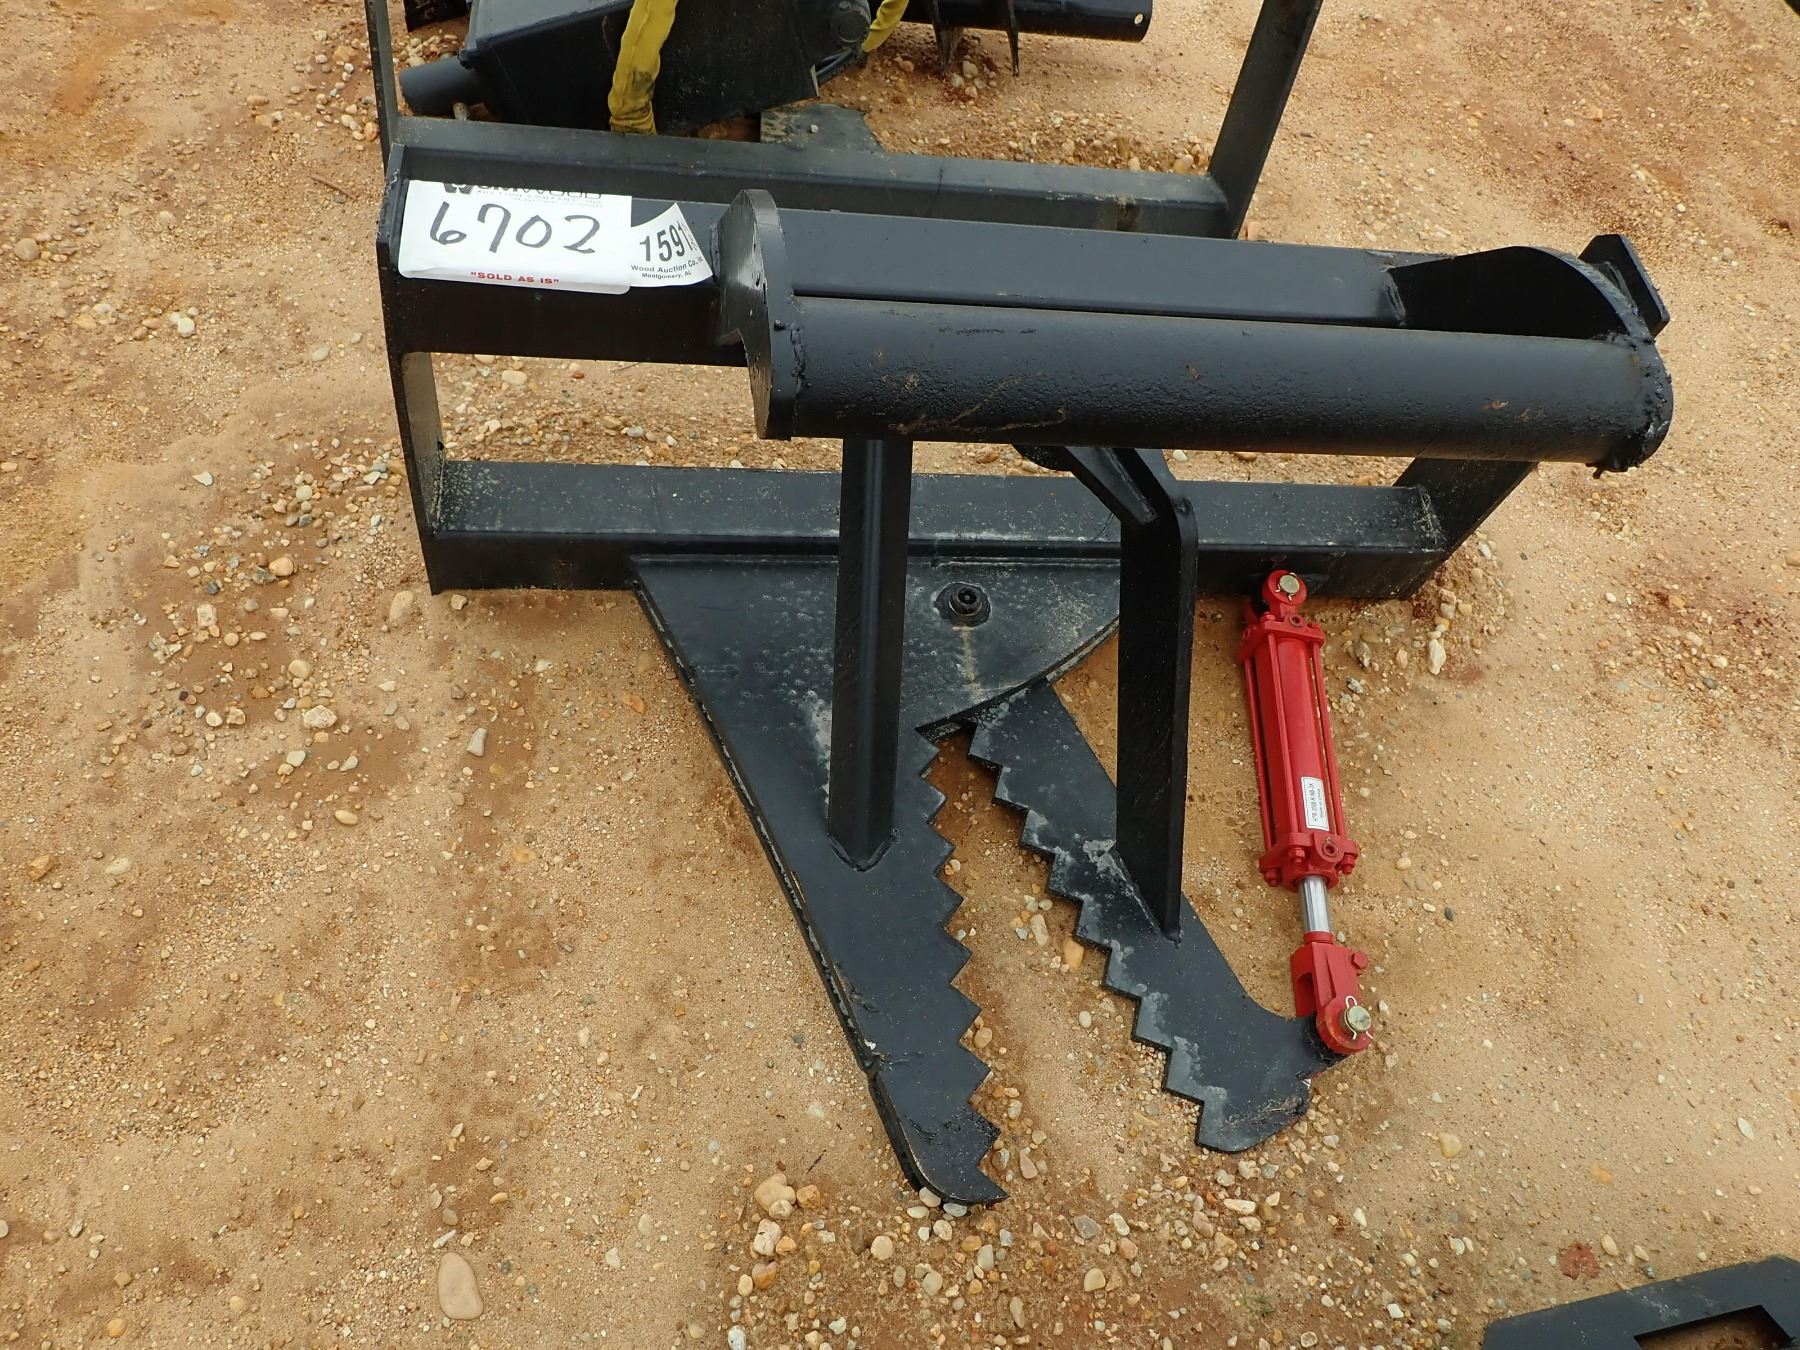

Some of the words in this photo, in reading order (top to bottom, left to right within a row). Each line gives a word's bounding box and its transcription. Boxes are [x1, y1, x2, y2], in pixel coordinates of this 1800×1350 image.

[429, 200, 601, 254] 6702
[639, 219, 693, 263] 1591
[470, 271, 513, 281] "SOLD
[517, 275, 535, 283] AS
[630, 264, 655, 273] Wood
[657, 263, 687, 274] Auction
